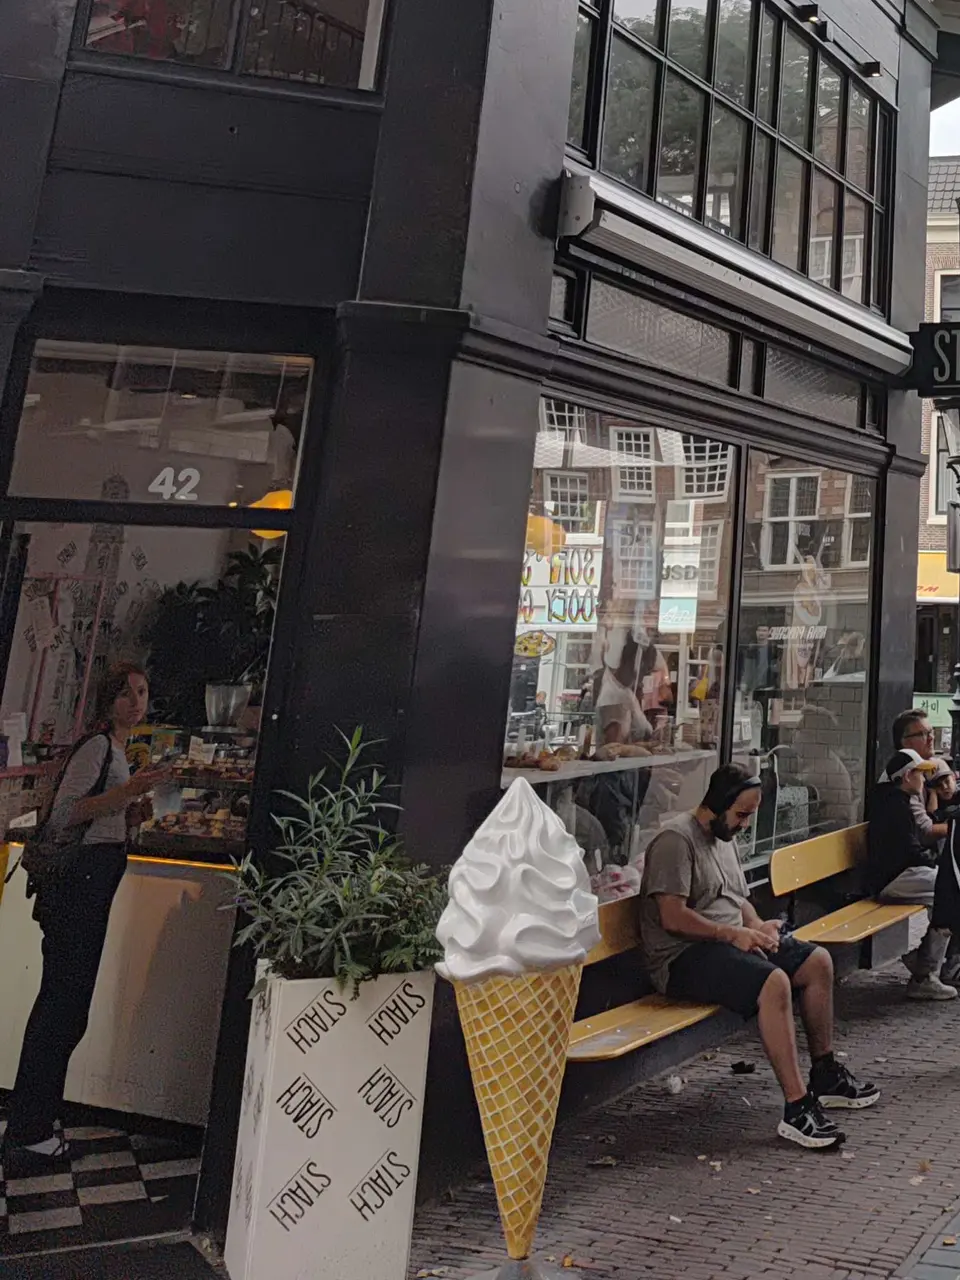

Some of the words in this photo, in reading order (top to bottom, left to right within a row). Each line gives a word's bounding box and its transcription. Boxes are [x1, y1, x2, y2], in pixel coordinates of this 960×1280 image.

[148, 466, 202, 501] 42
[286, 989, 348, 1054] STACH
[367, 982, 426, 1046] STACH
[276, 1075, 334, 1139] STACH
[357, 1067, 413, 1129] STACH
[269, 1161, 332, 1232] STACH
[349, 1150, 411, 1222] STACH
